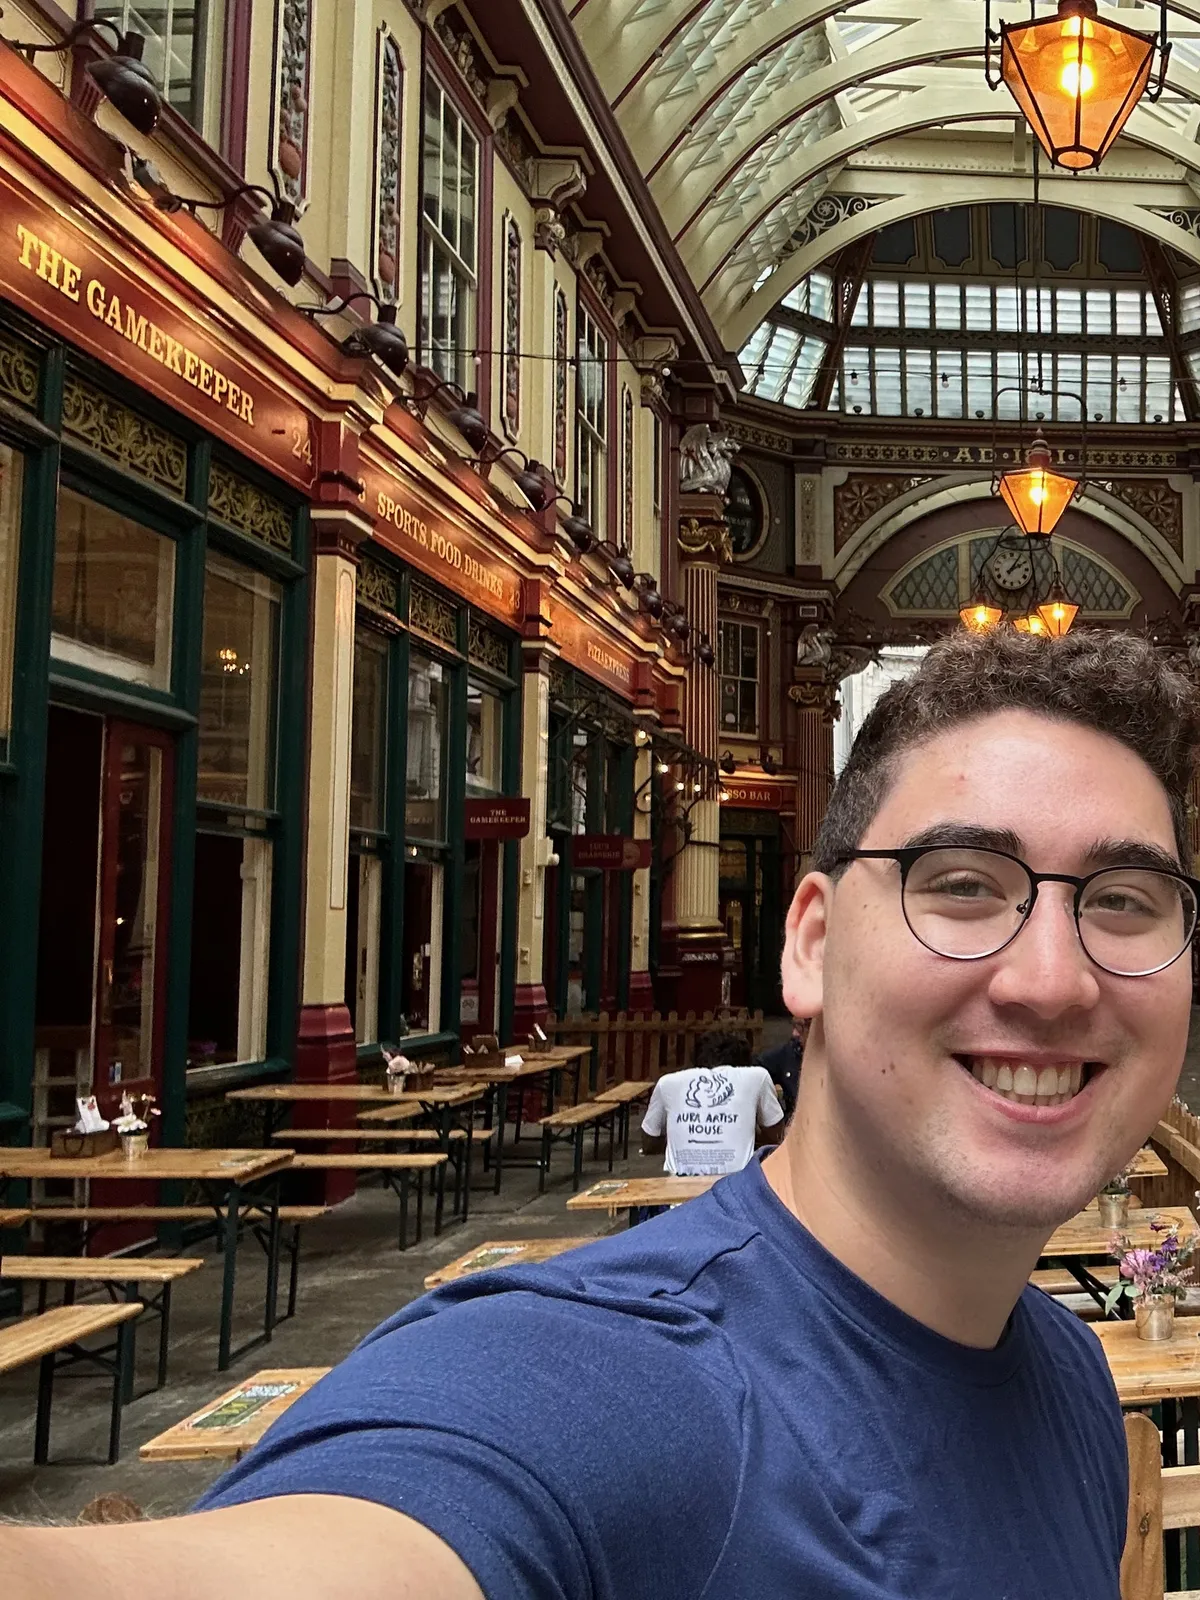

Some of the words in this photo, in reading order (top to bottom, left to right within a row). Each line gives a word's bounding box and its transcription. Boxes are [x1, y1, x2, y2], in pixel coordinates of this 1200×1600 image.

[16, 223, 82, 303] THE
[86, 278, 255, 426] GAMEKEEPER
[291, 427, 313, 467] 24
[377, 491, 429, 550] SPORTS,
[430, 529, 463, 572] FOOD,
[464, 553, 504, 599] DRINKS
[750, 790, 771, 802] BAR
[676, 1112, 700, 1124] AURA
[705, 1111, 739, 1124] ARTIST
[688, 1124, 723, 1135] HOUSE
